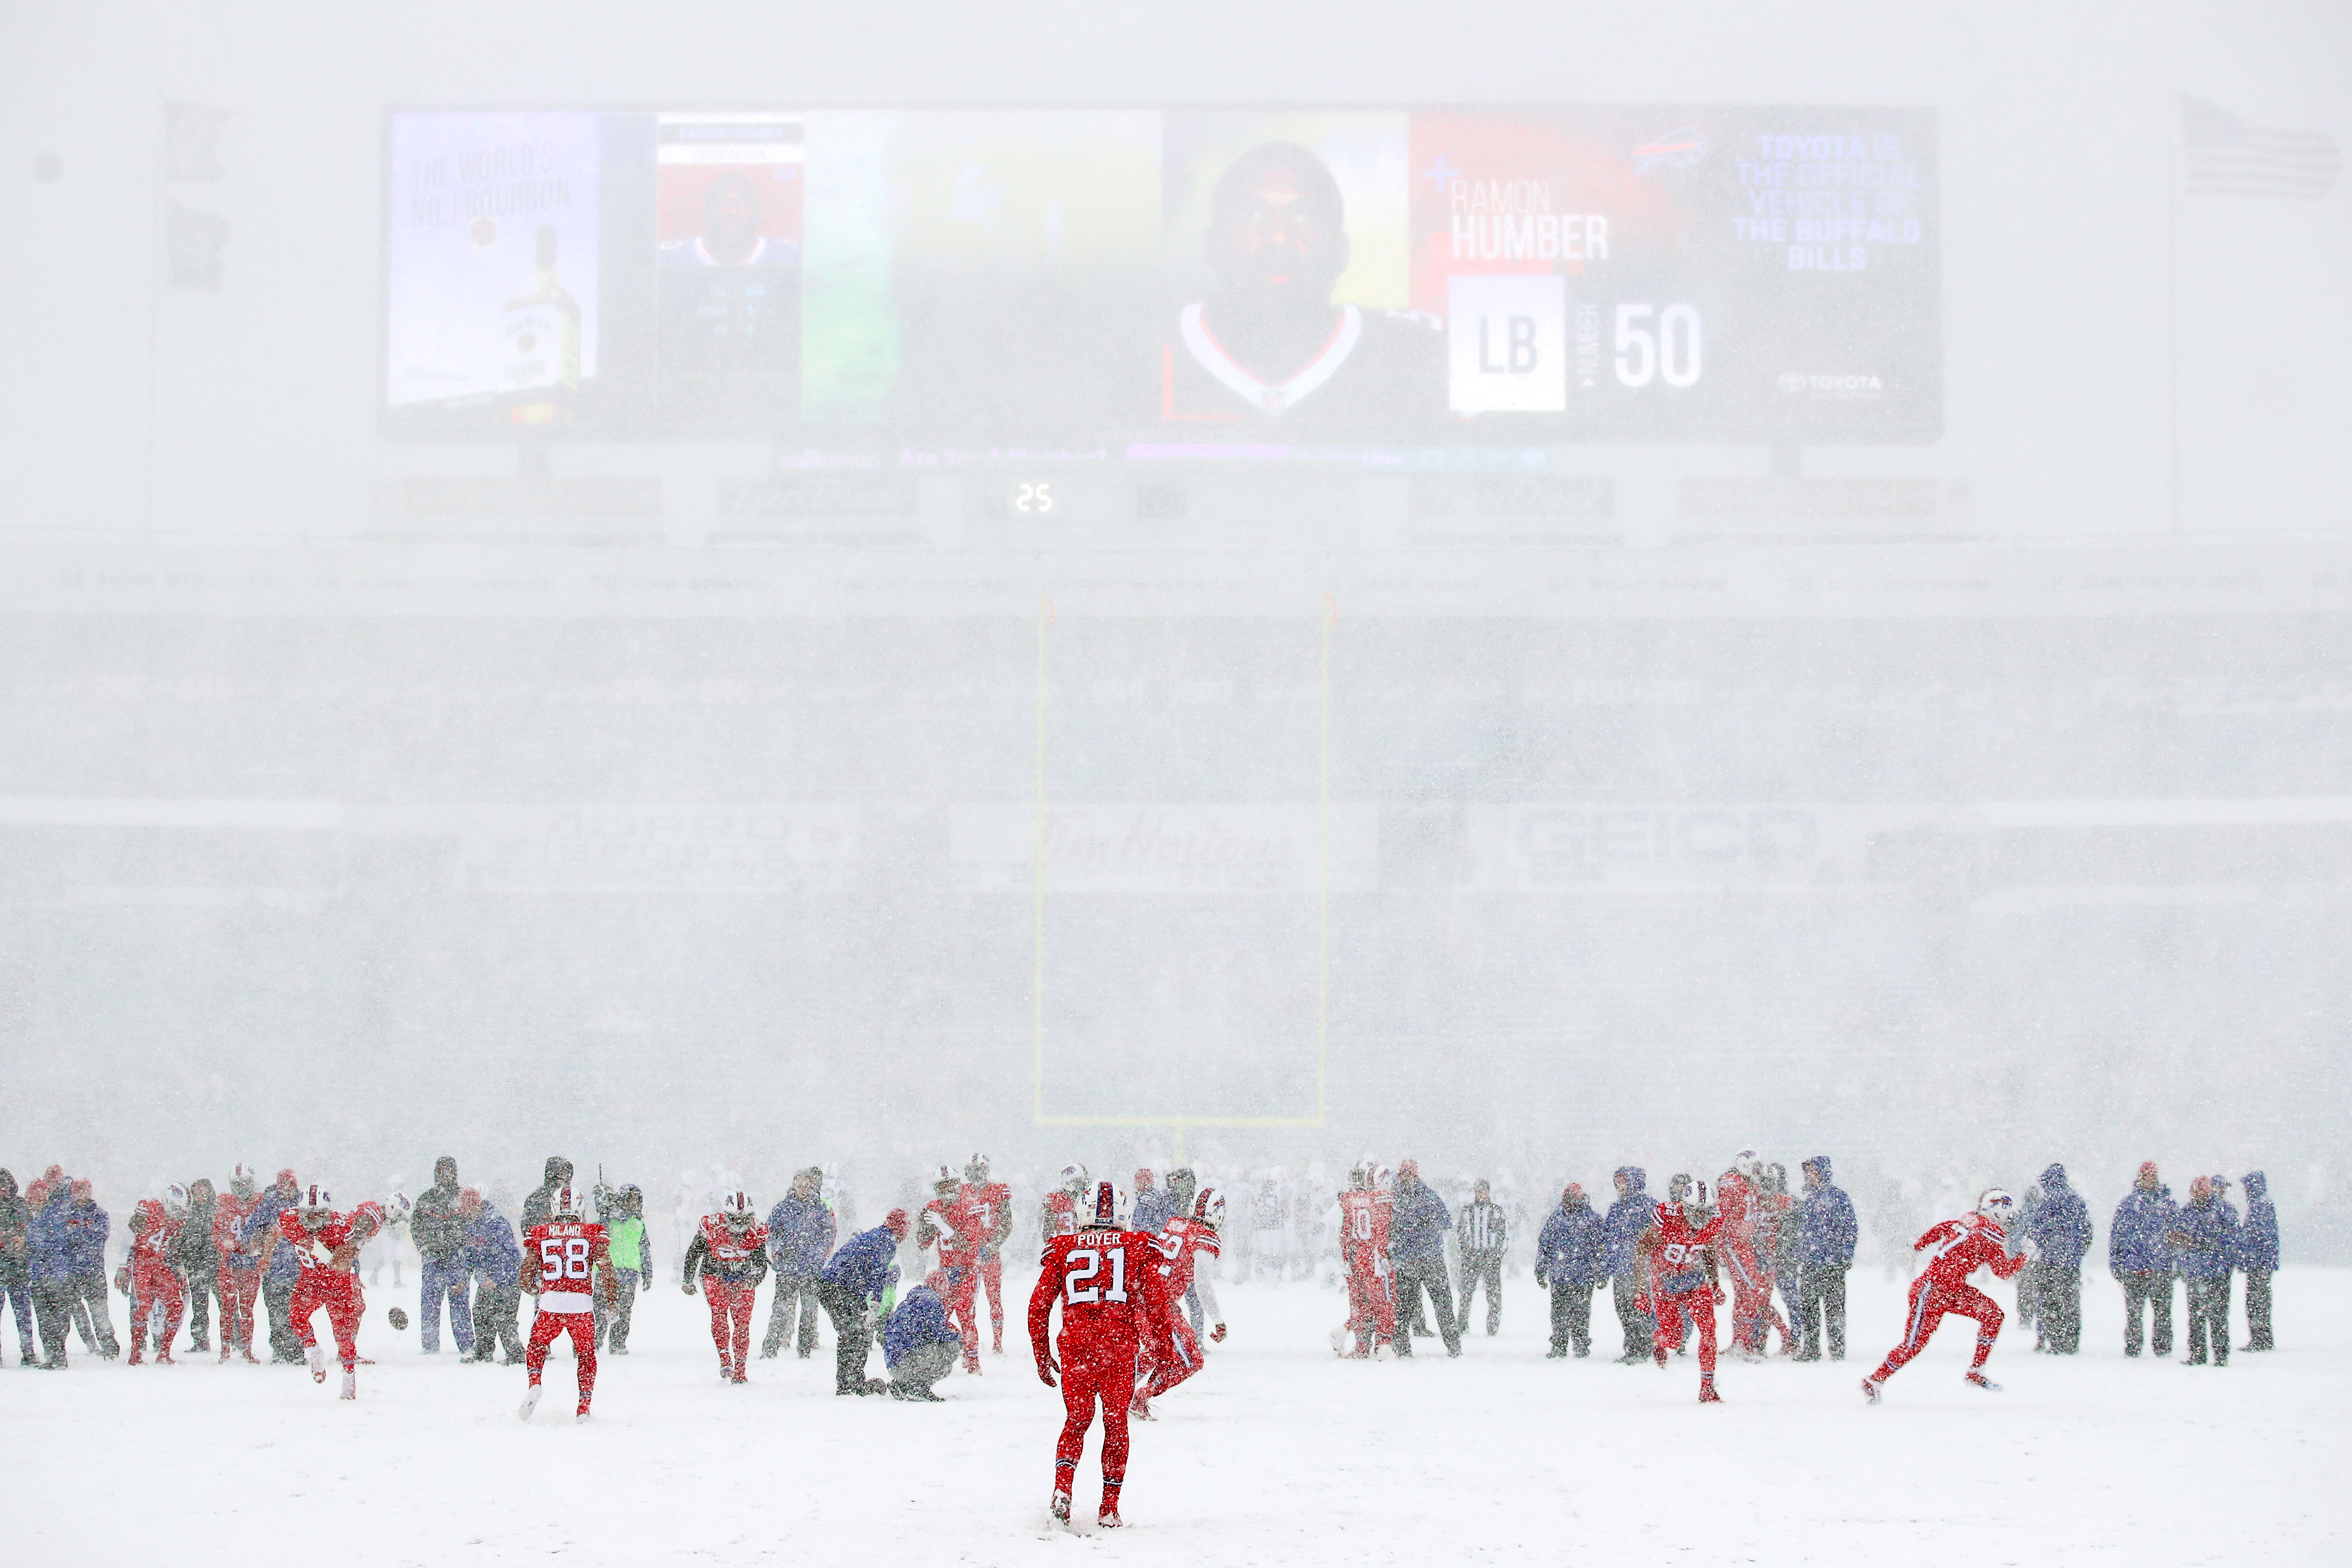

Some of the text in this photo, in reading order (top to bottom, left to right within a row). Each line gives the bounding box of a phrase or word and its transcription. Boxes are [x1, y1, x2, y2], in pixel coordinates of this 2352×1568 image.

[1757, 134, 1901, 160] TOYOTA IS
[412, 141, 554, 191] THE WORLD'S
[1735, 162, 1922, 188] THE OFFICIAL
[465, 177, 571, 222] BOURBON
[1451, 180, 1550, 215] RAMON
[1747, 190, 1912, 216] VEHICLE OF
[1451, 215, 1609, 261] HUMBER
[1731, 217, 1921, 244] THE BUFFALO
[1787, 245, 1867, 271] BILLS
[1479, 314, 1539, 375] LB
[1577, 303, 1600, 377] NUMBER
[1614, 302, 1703, 389] 50
[1808, 375, 1883, 391] TOYOTA
[1015, 483, 1054, 512] 25
[1516, 809, 1820, 862] GEICO
[548, 1225, 581, 1236] MILANO
[1077, 1233, 1122, 1246] POYER
[540, 1238, 590, 1280] 58
[1065, 1248, 1128, 1305] 21
